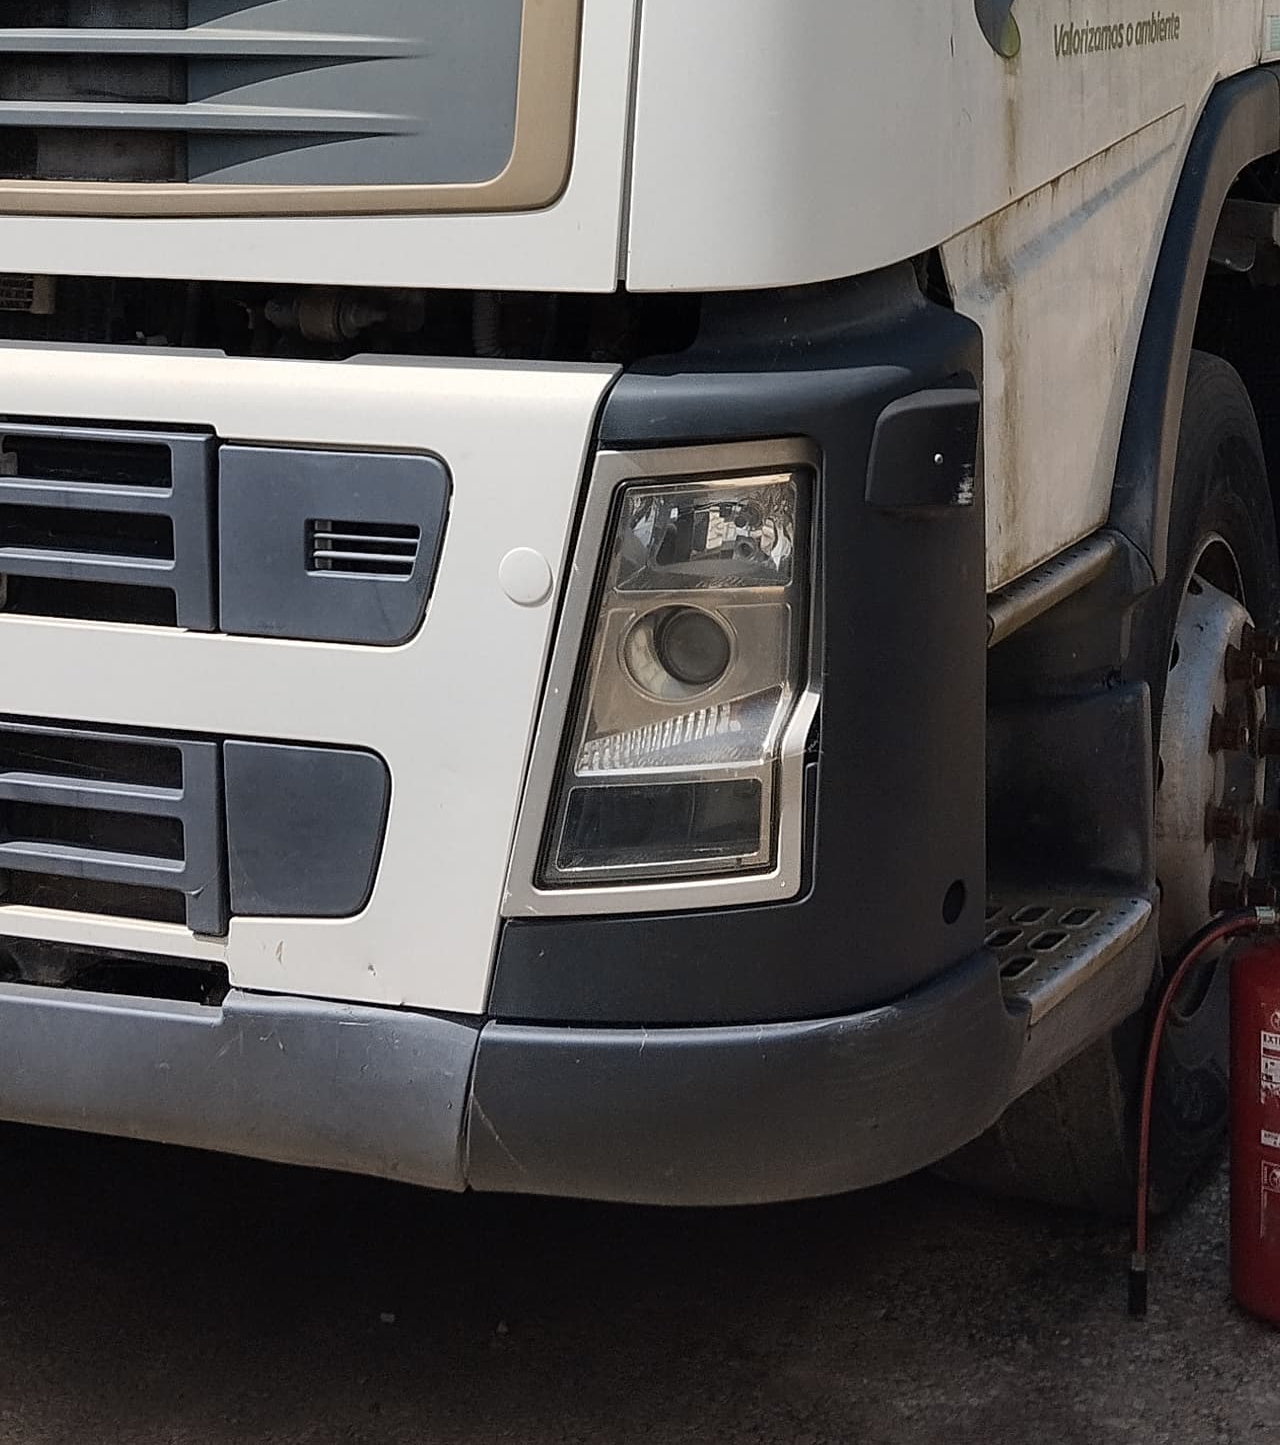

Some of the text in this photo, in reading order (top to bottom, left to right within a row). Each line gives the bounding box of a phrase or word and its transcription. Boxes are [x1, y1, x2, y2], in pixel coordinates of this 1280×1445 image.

[1054, 11, 1180, 57] Valorizamos o ambiente
